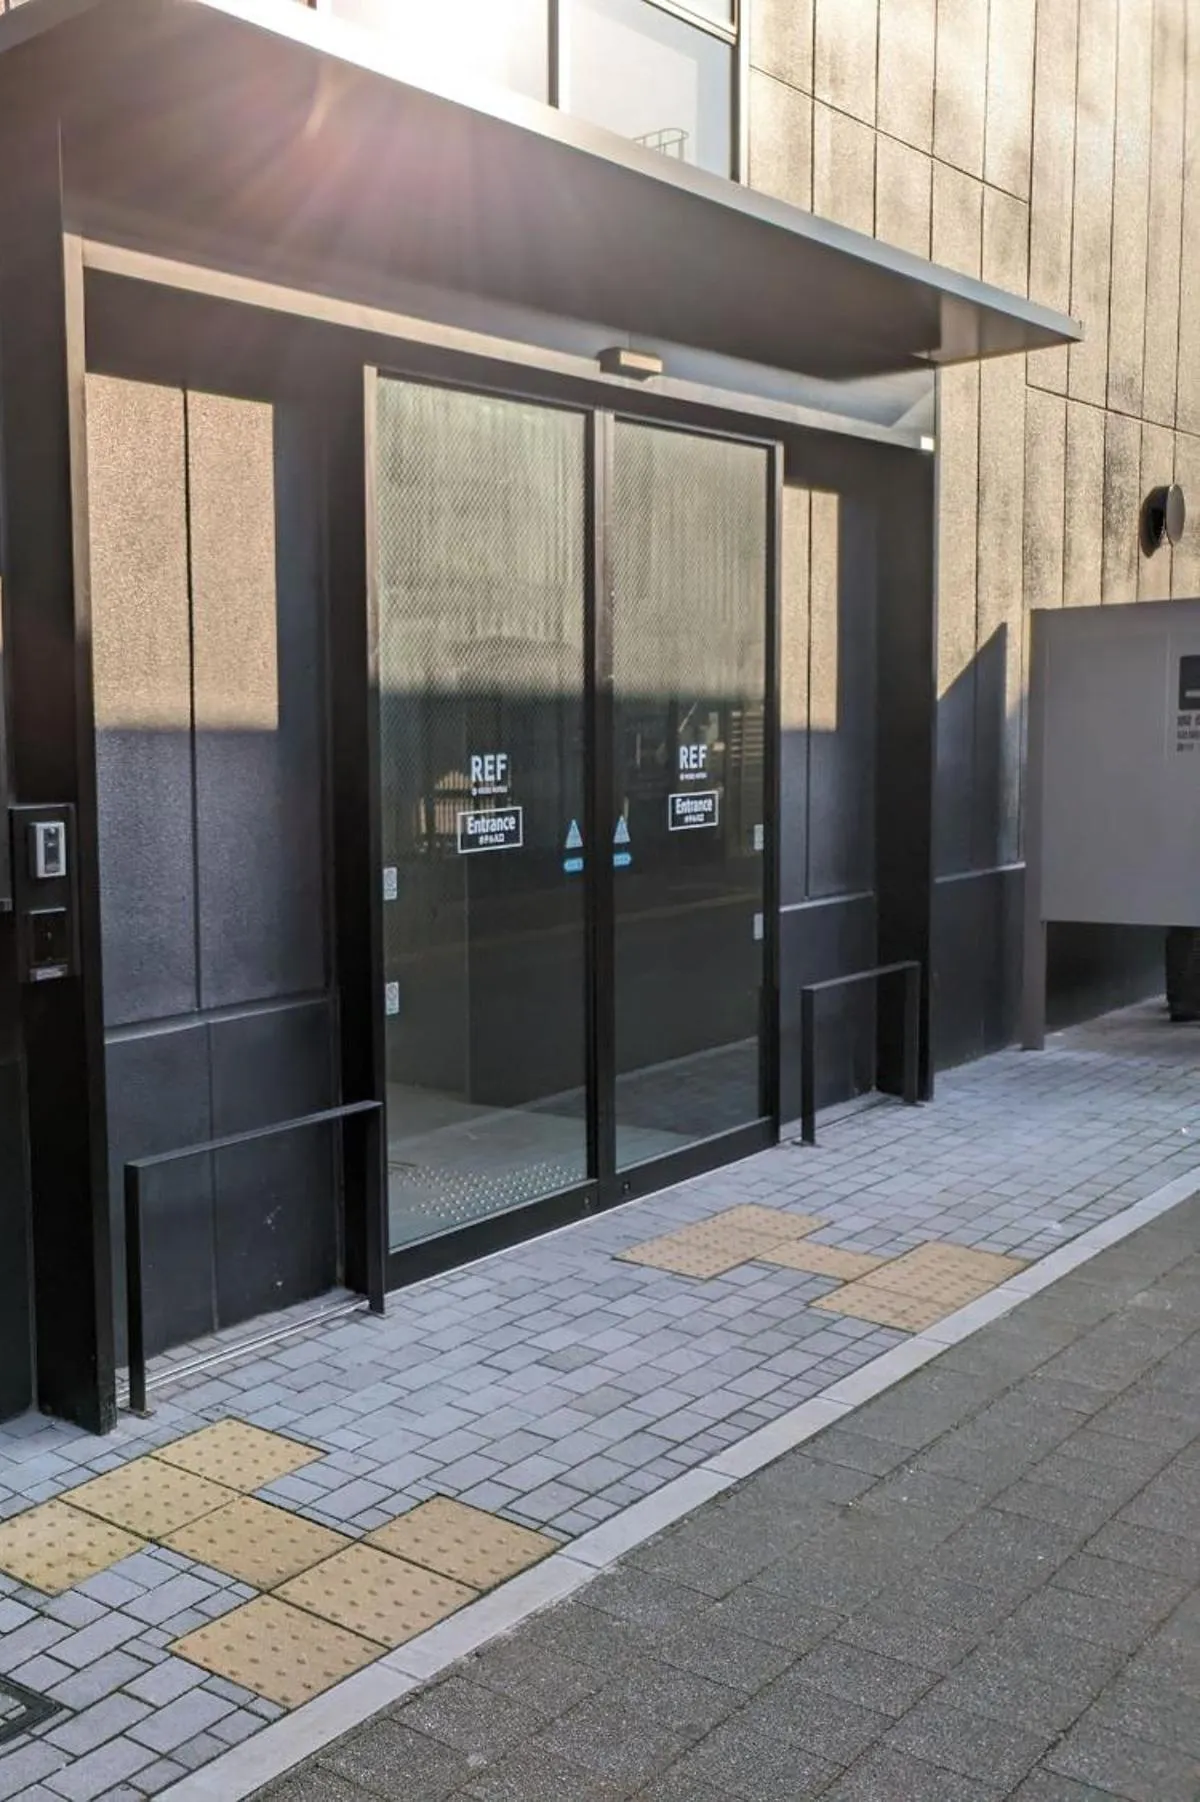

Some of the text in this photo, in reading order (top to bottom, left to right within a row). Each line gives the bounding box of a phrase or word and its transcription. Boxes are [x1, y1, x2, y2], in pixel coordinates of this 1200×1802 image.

[471, 753, 508, 782] REF
[679, 744, 708, 769] REF
[676, 797, 713, 815] Entrance
[467, 815, 516, 834] Entrance
